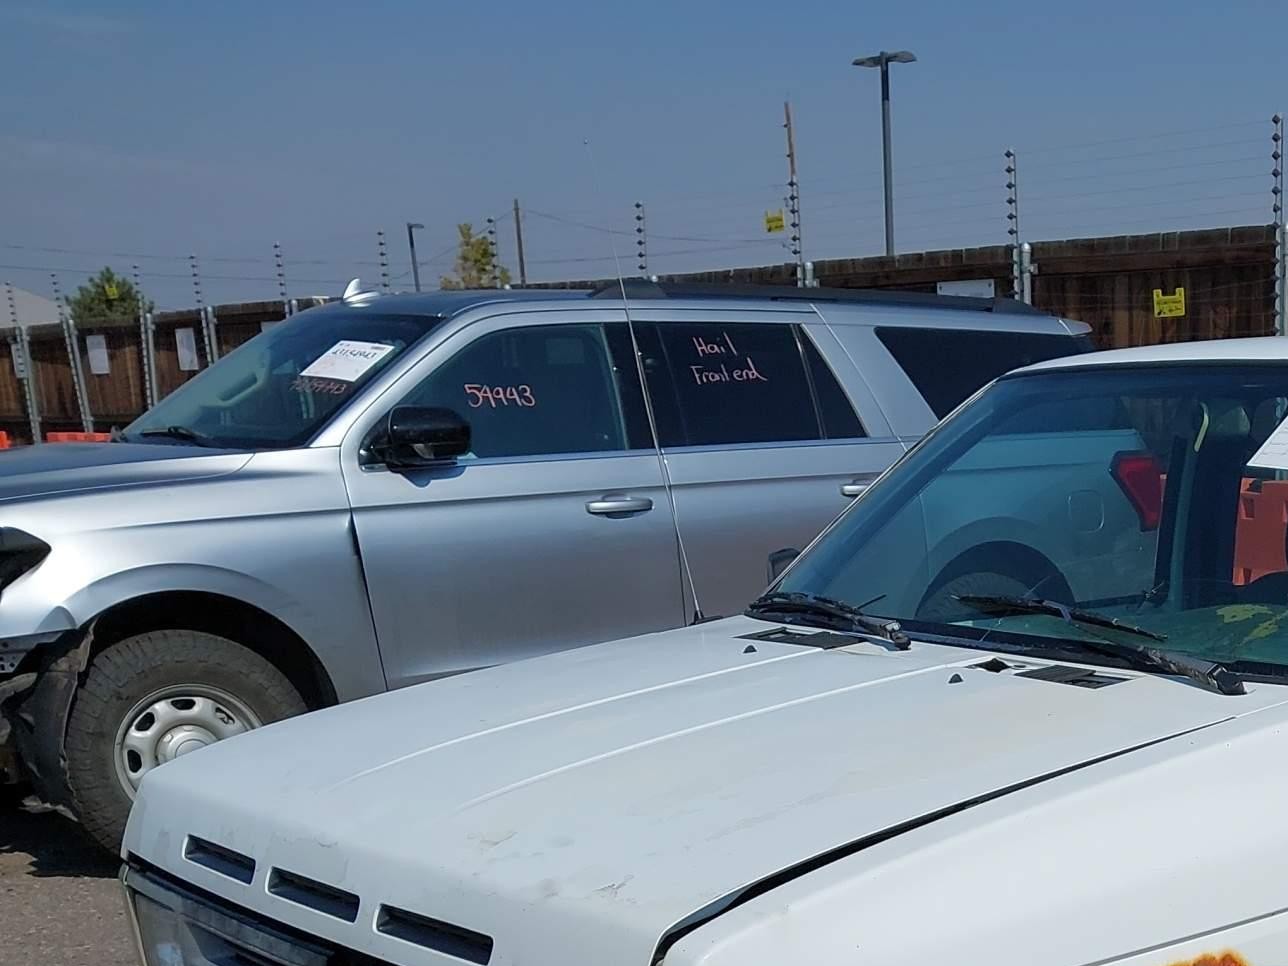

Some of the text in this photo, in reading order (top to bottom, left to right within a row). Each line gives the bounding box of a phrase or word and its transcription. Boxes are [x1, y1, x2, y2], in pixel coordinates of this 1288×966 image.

[692, 331, 738, 358] Hail
[732, 356, 768, 381] end
[464, 384, 536, 408] 54943
